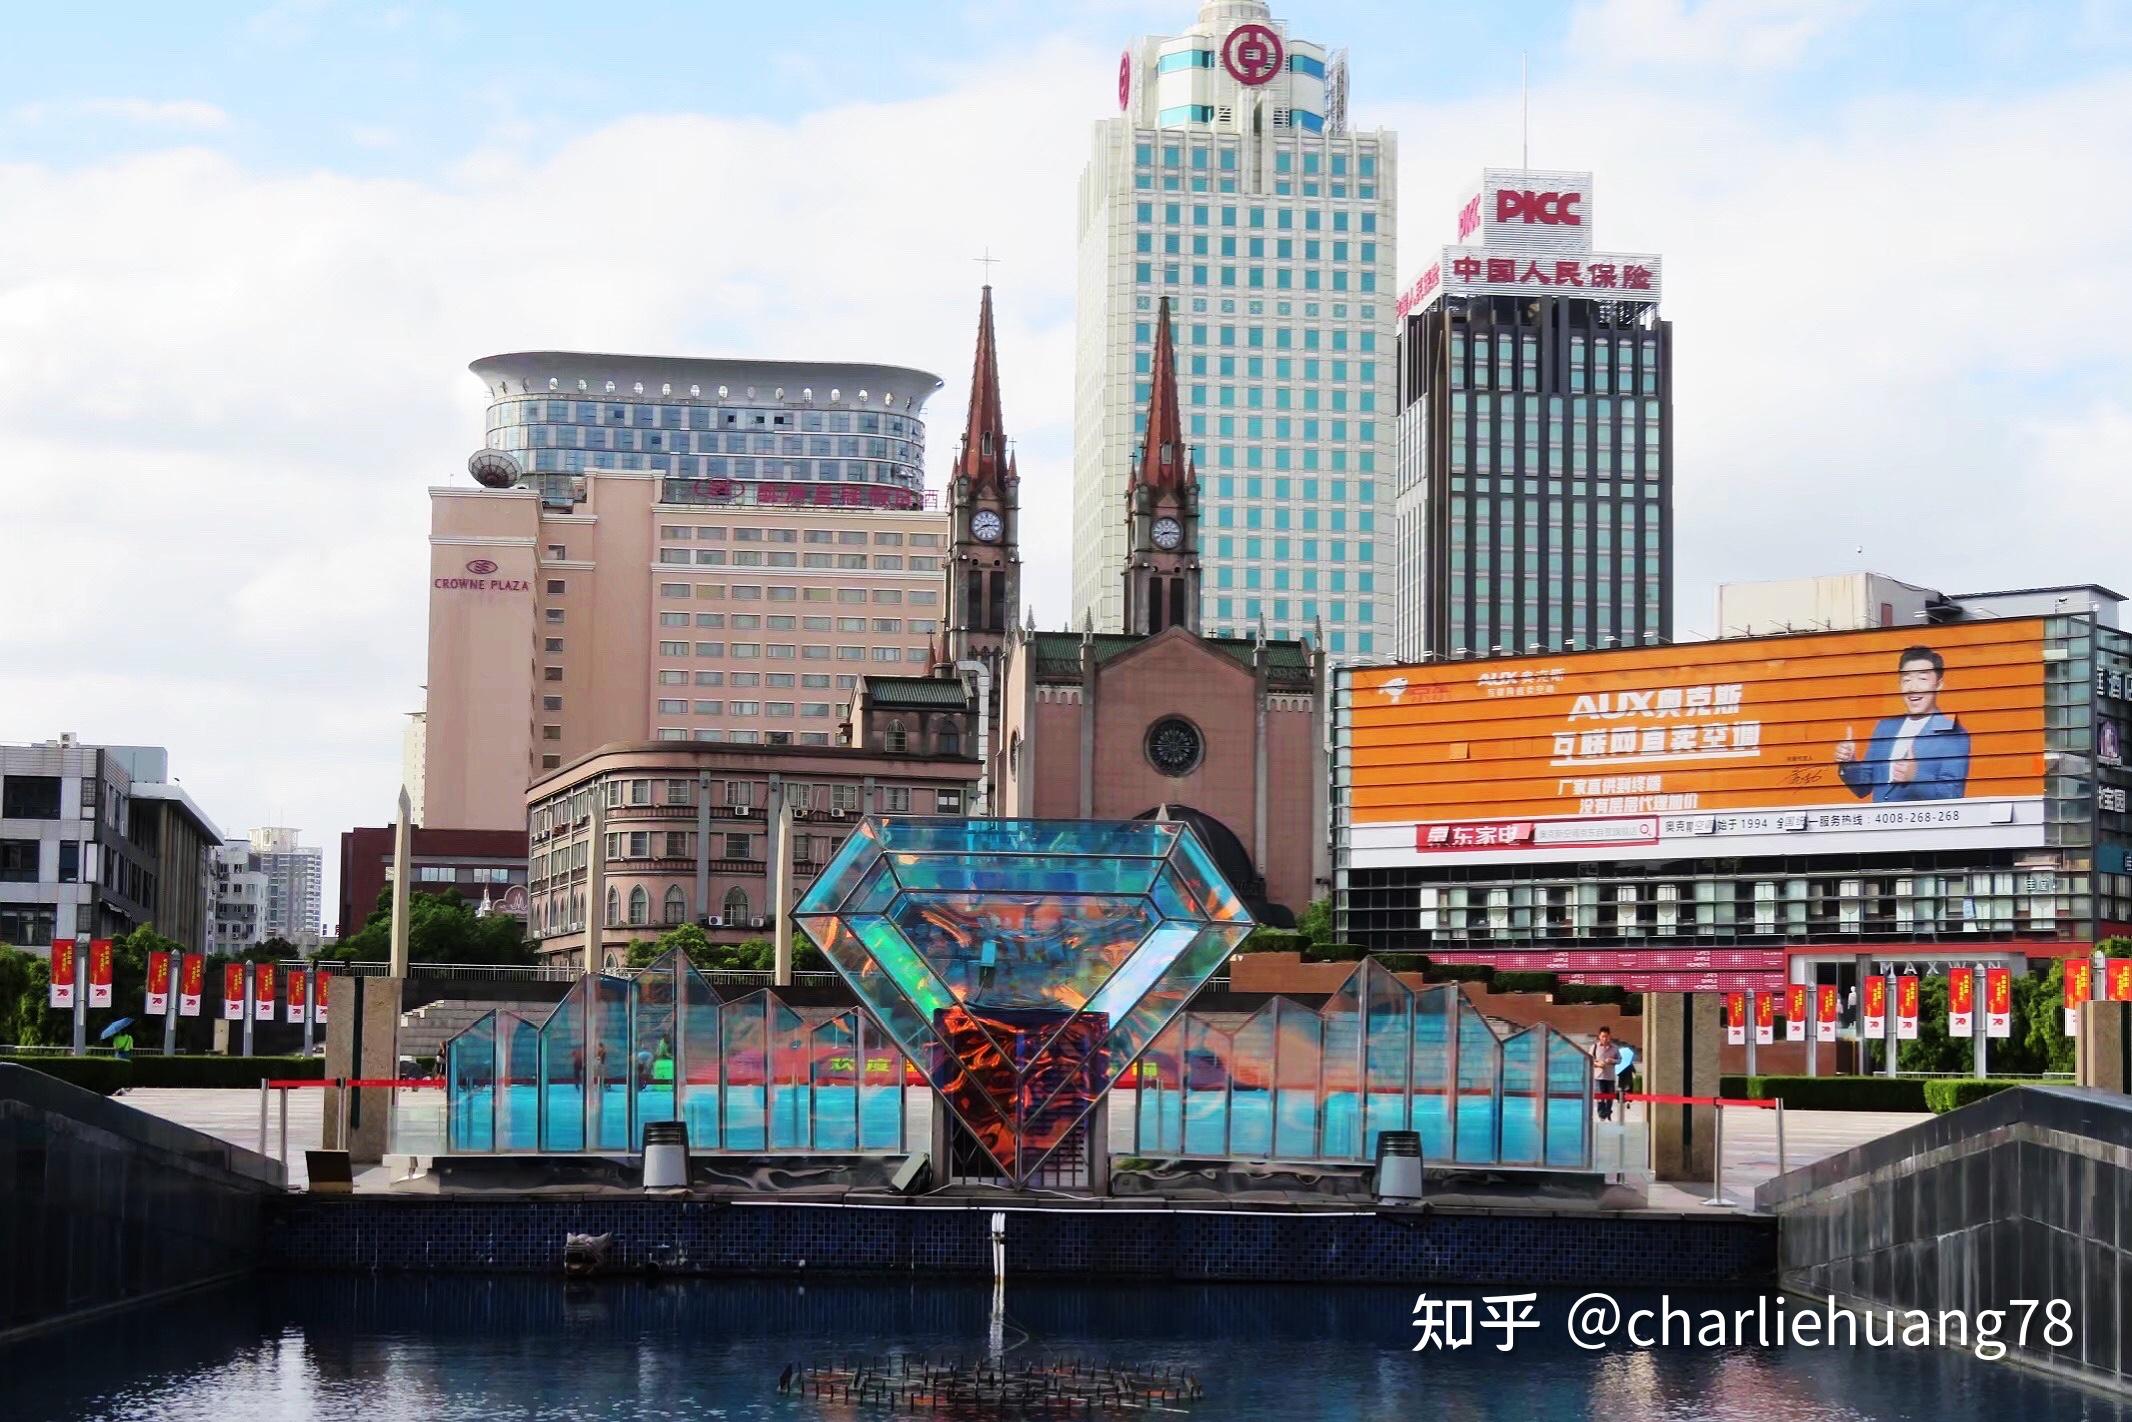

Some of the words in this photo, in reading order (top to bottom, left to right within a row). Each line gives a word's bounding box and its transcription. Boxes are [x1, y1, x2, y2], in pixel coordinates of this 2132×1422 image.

[1496, 189, 1582, 225] PICC
[1453, 256, 1654, 289] 中国人民保险
[434, 578, 485, 590] CROWNE
[490, 580, 529, 591] PLAZA
[1742, 819, 1768, 829] 1994
[1875, 811, 1960, 824] 4008-268-268
